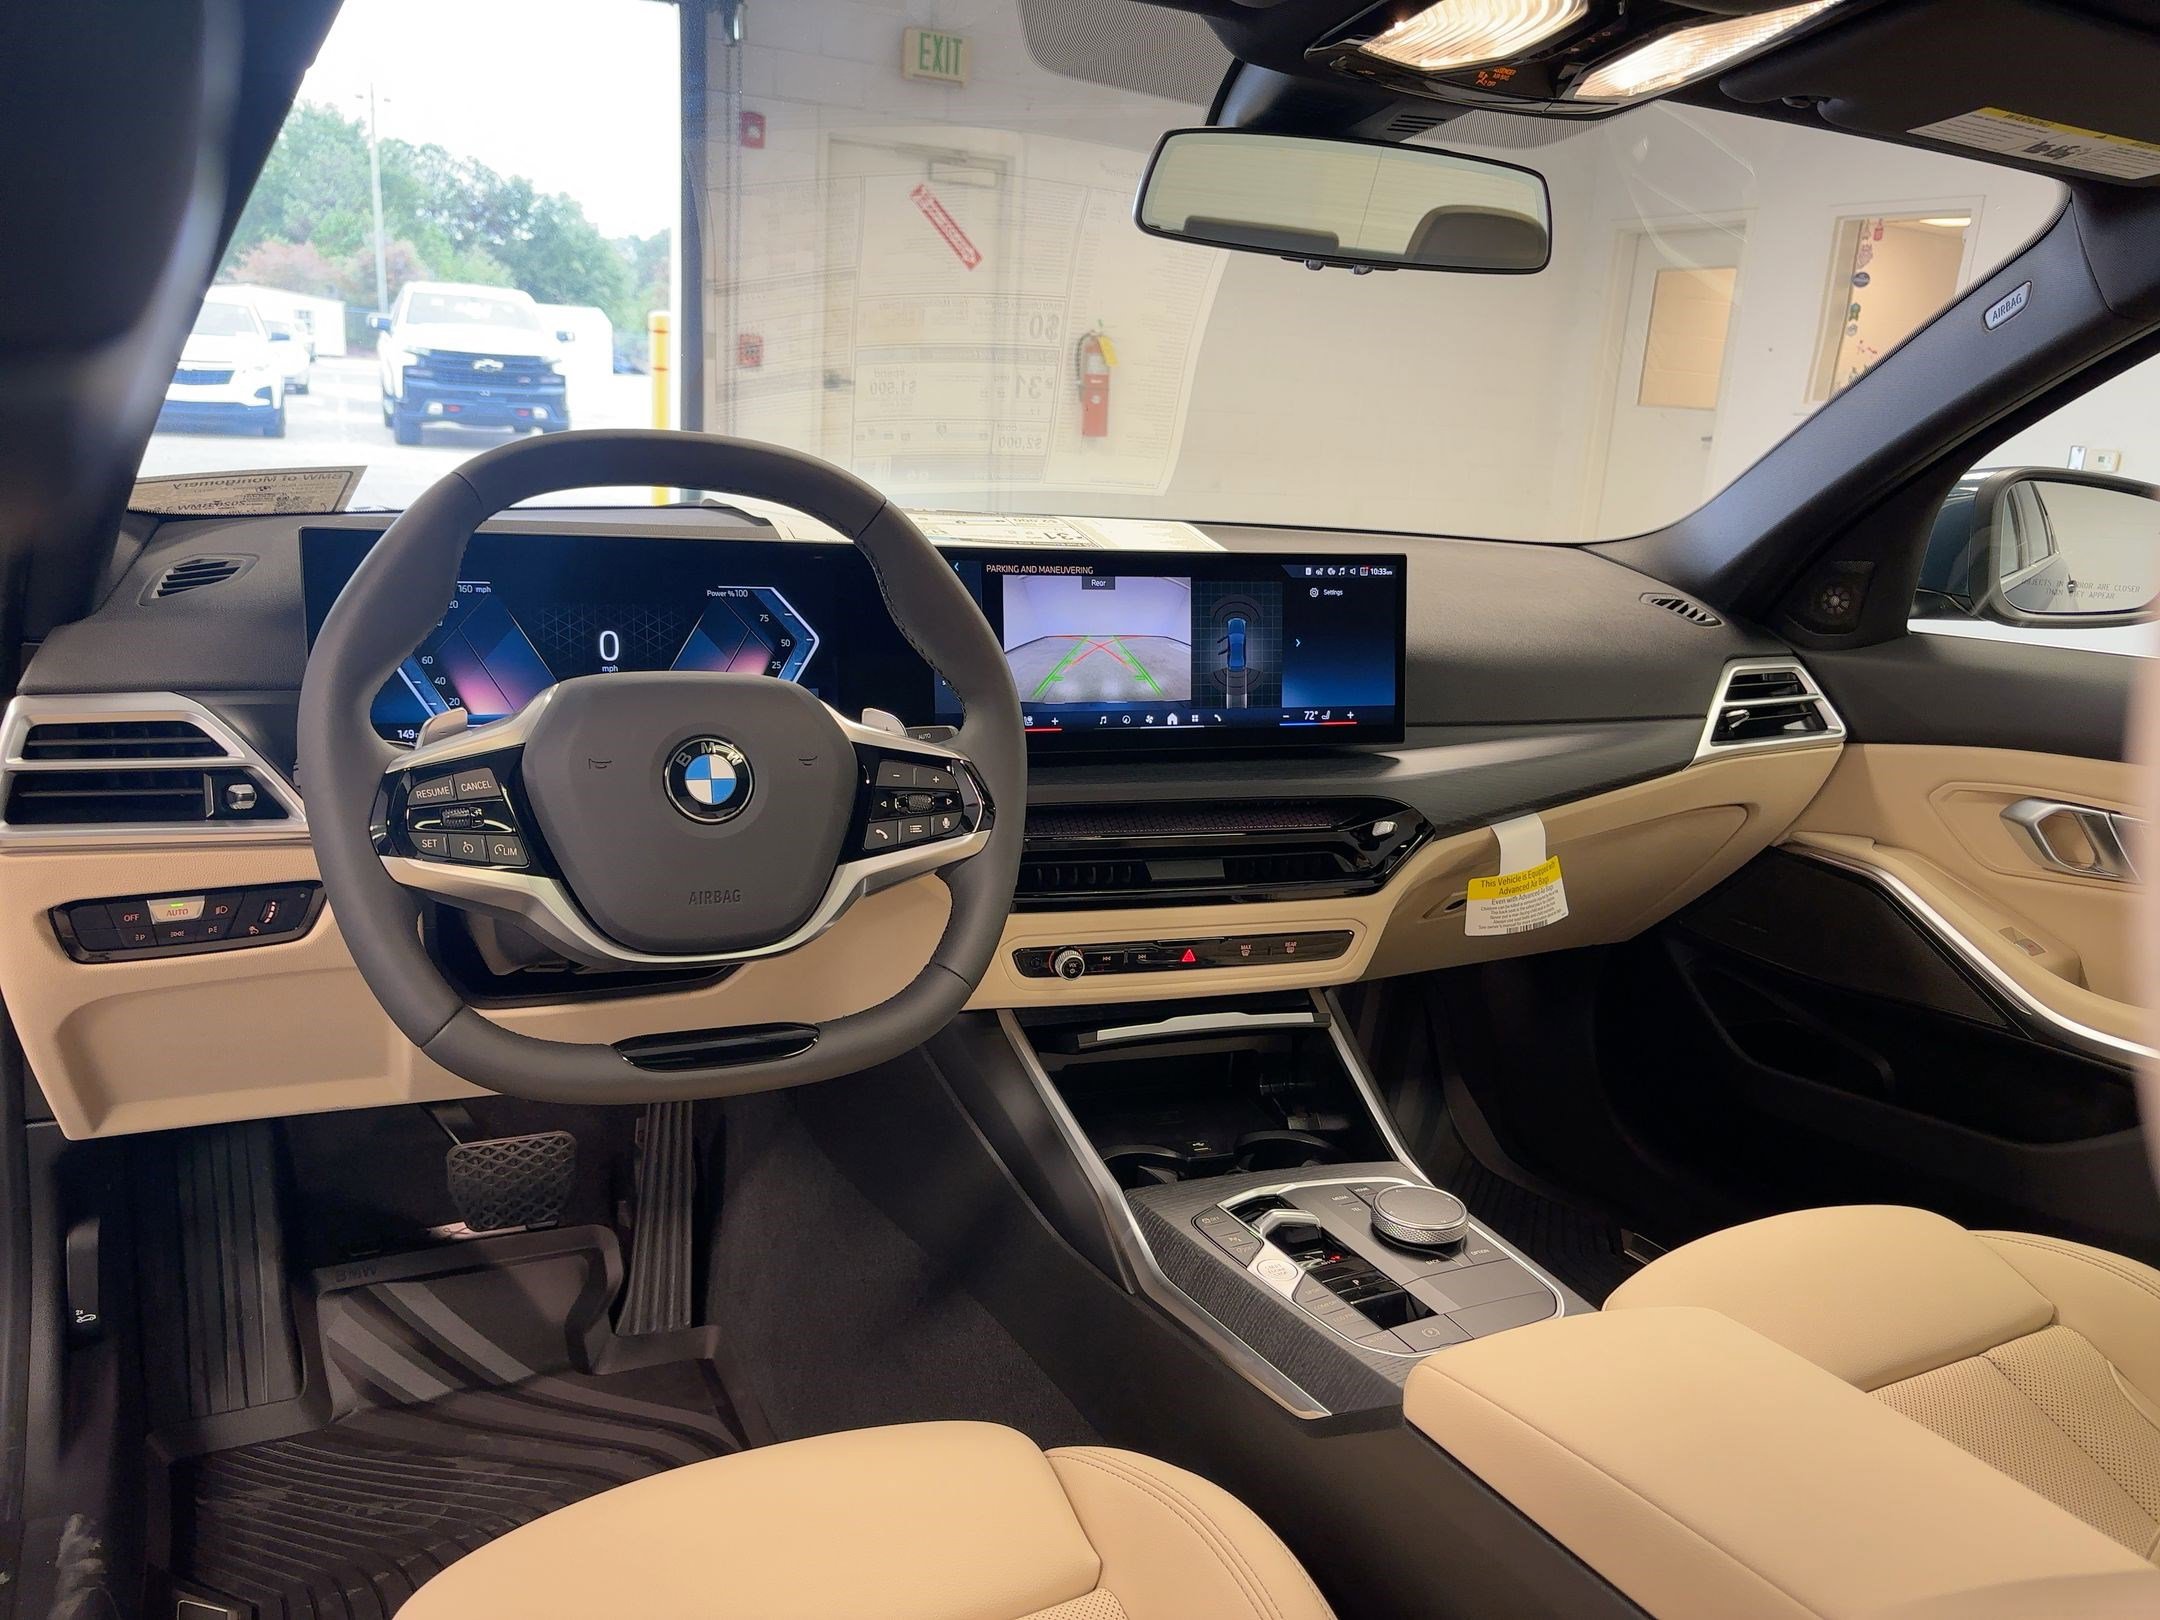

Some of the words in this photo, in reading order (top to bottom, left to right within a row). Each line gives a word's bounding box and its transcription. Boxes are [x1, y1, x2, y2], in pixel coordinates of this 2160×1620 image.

[920, 32, 962, 75] EXIT
[1992, 293, 2022, 322] AIRBAG
[986, 564, 1019, 574] PARKING
[1020, 565, 1037, 574] AND
[1038, 566, 1094, 575] MANEUVERING
[1091, 579, 1107, 587] Rear
[2097, 583, 2111, 591] ARE
[2114, 584, 2141, 592] CLOSER
[475, 586, 492, 594] mph
[706, 589, 727, 597] Power
[1323, 588, 1344, 597] Settings
[2089, 591, 2116, 599] APPEAR
[759, 614, 770, 622] 75
[600, 630, 620, 662] 0
[780, 638, 791, 647] 50
[421, 655, 434, 665] 60
[771, 660, 782, 669] 25
[601, 664, 619, 673] mph
[434, 676, 447, 686] 40
[448, 697, 461, 706] 20
[397, 729, 415, 739] 149
[460, 779, 493, 793] CANCEL
[416, 786, 450, 799] RESUME
[421, 839, 438, 849] SET
[502, 846, 518, 857] LIM
[1480, 879, 1497, 889] This
[1497, 872, 1522, 886] Vehicle
[1498, 882, 1530, 897] Advanced
[688, 888, 742, 905] AIRBAG
[123, 913, 140, 922] OFF
[166, 908, 189, 917] AUTO
